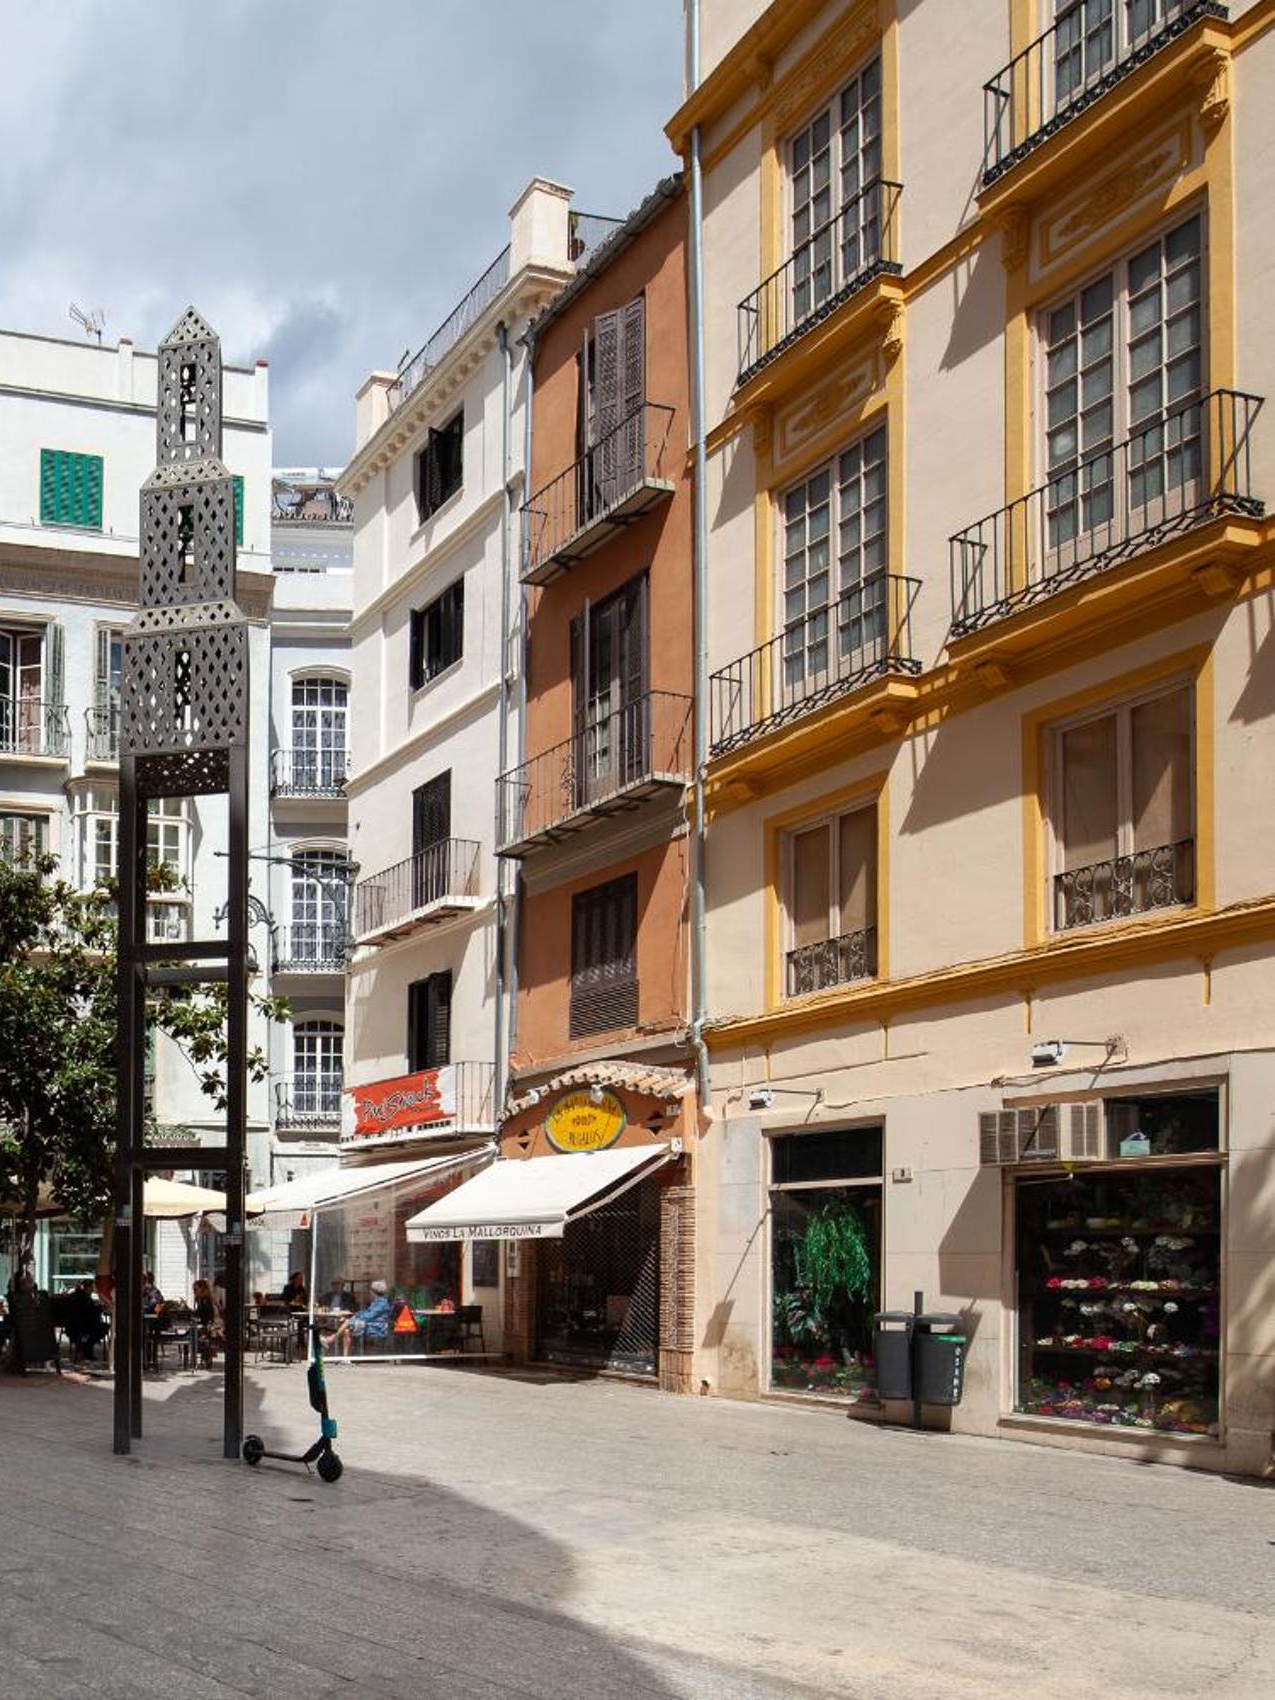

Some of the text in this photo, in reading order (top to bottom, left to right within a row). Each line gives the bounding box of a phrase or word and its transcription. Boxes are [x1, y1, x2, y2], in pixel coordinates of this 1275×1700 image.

[424, 1225, 542, 1239] VINOS LA MALLORQUINA
